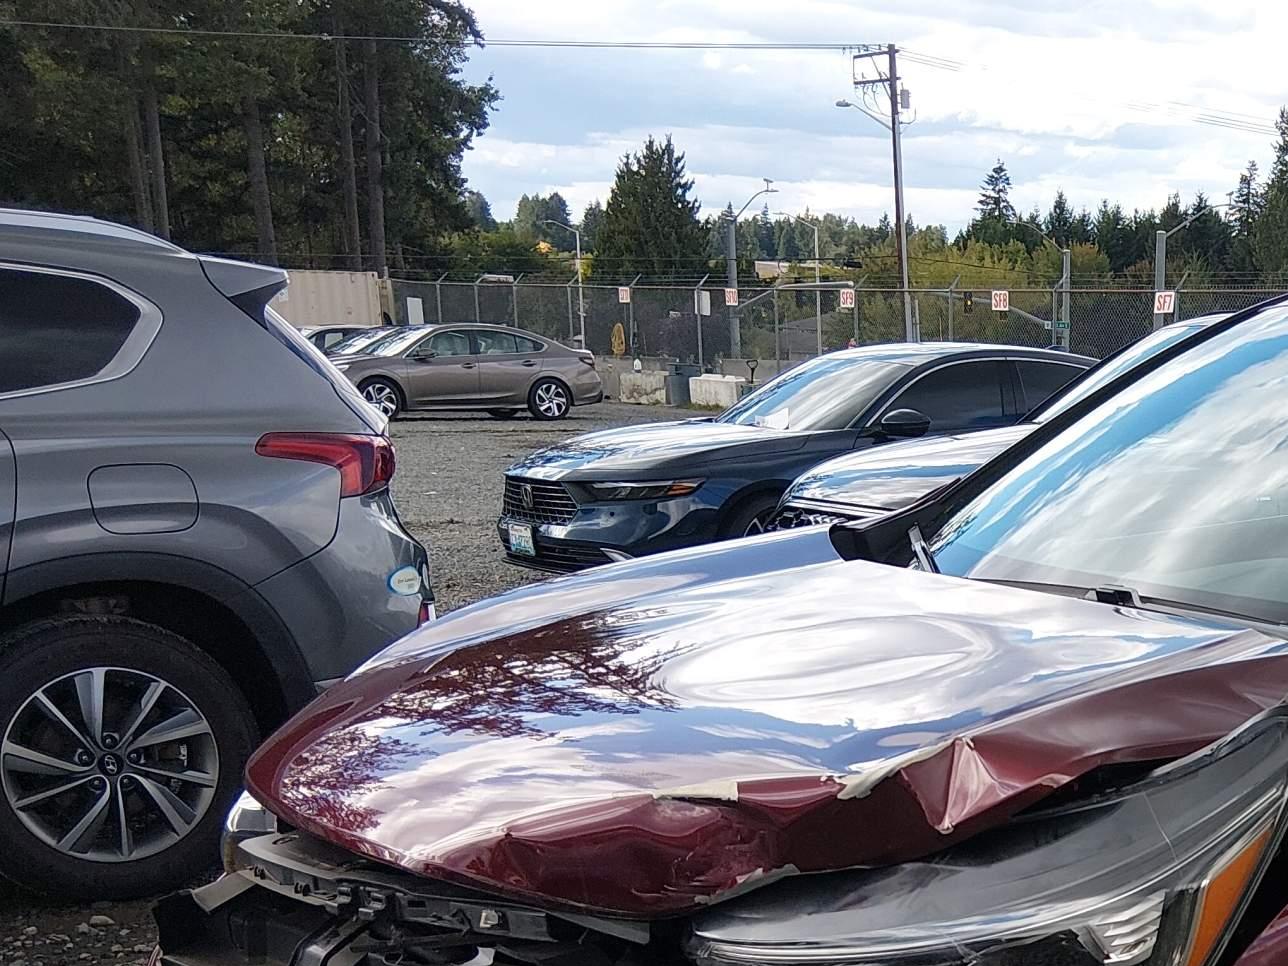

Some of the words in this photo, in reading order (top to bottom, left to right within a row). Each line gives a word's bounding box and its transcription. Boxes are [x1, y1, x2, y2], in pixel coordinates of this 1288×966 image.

[841, 291, 854, 305] SF9
[993, 292, 1008, 309] SF8
[1156, 294, 1173, 311] SF7
